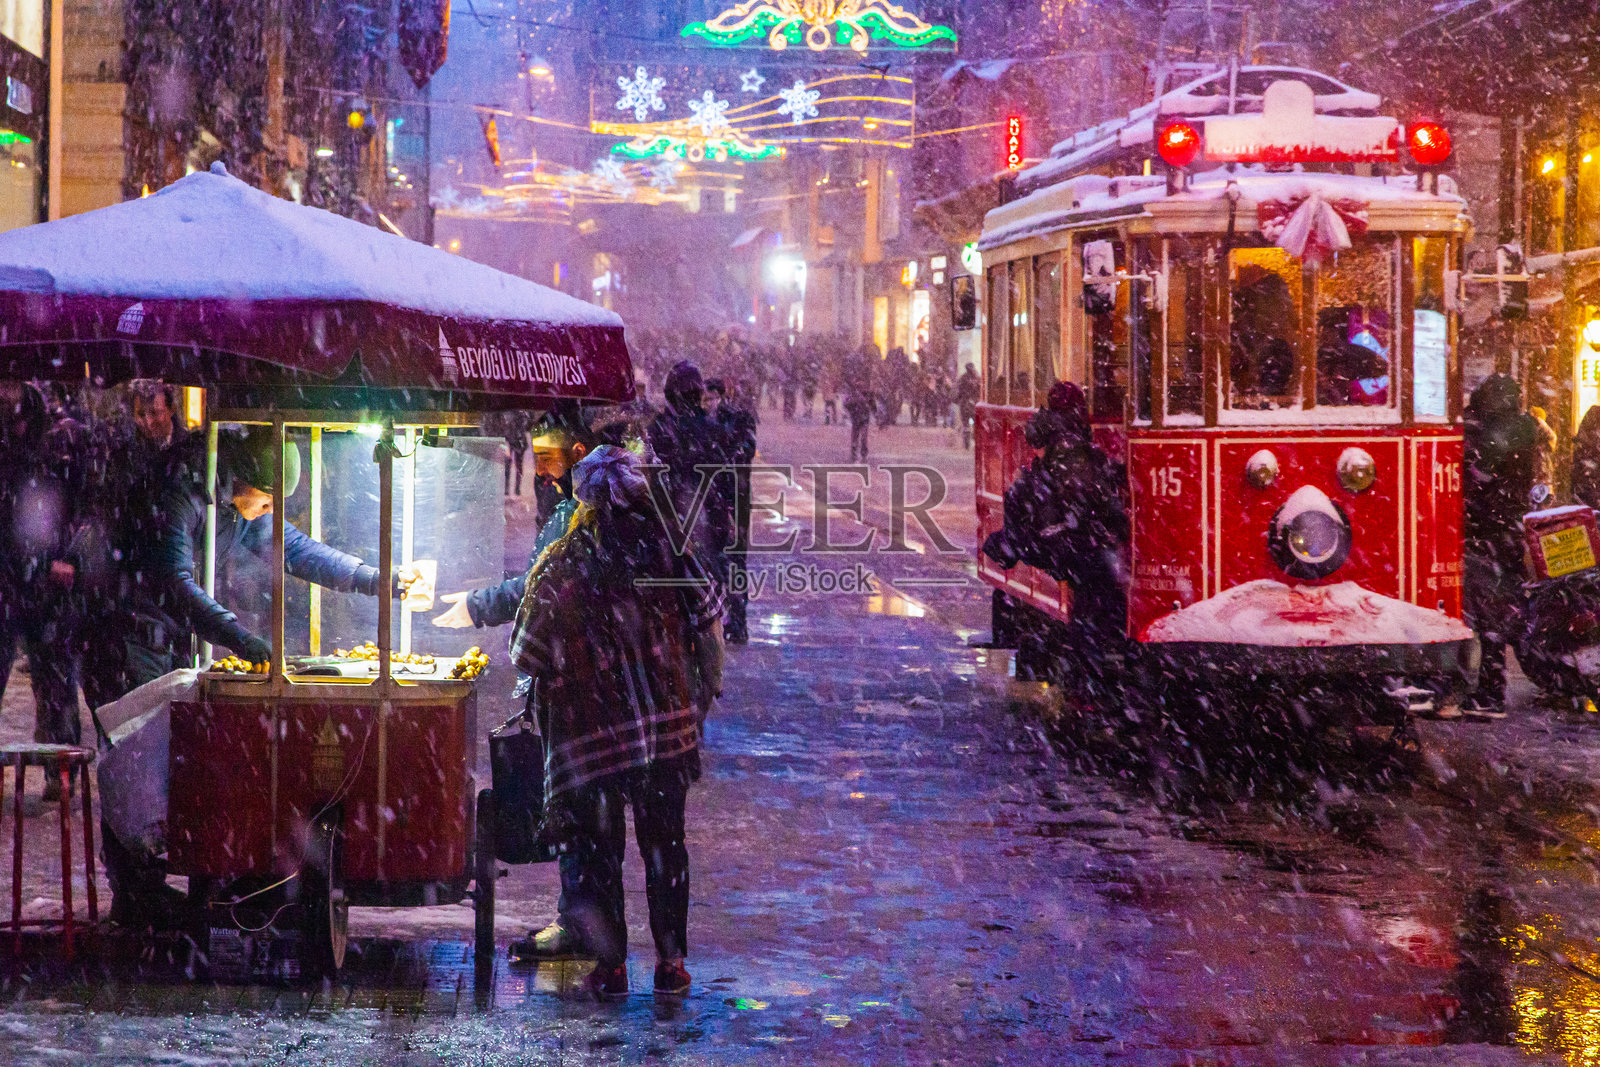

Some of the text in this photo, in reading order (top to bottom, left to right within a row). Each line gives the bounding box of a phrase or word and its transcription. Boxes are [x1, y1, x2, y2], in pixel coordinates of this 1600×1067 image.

[457, 345, 588, 386] BEYOĞLU BELEDİYESİ
[1149, 466, 1182, 497] 115
[1436, 462, 1460, 493] 115
